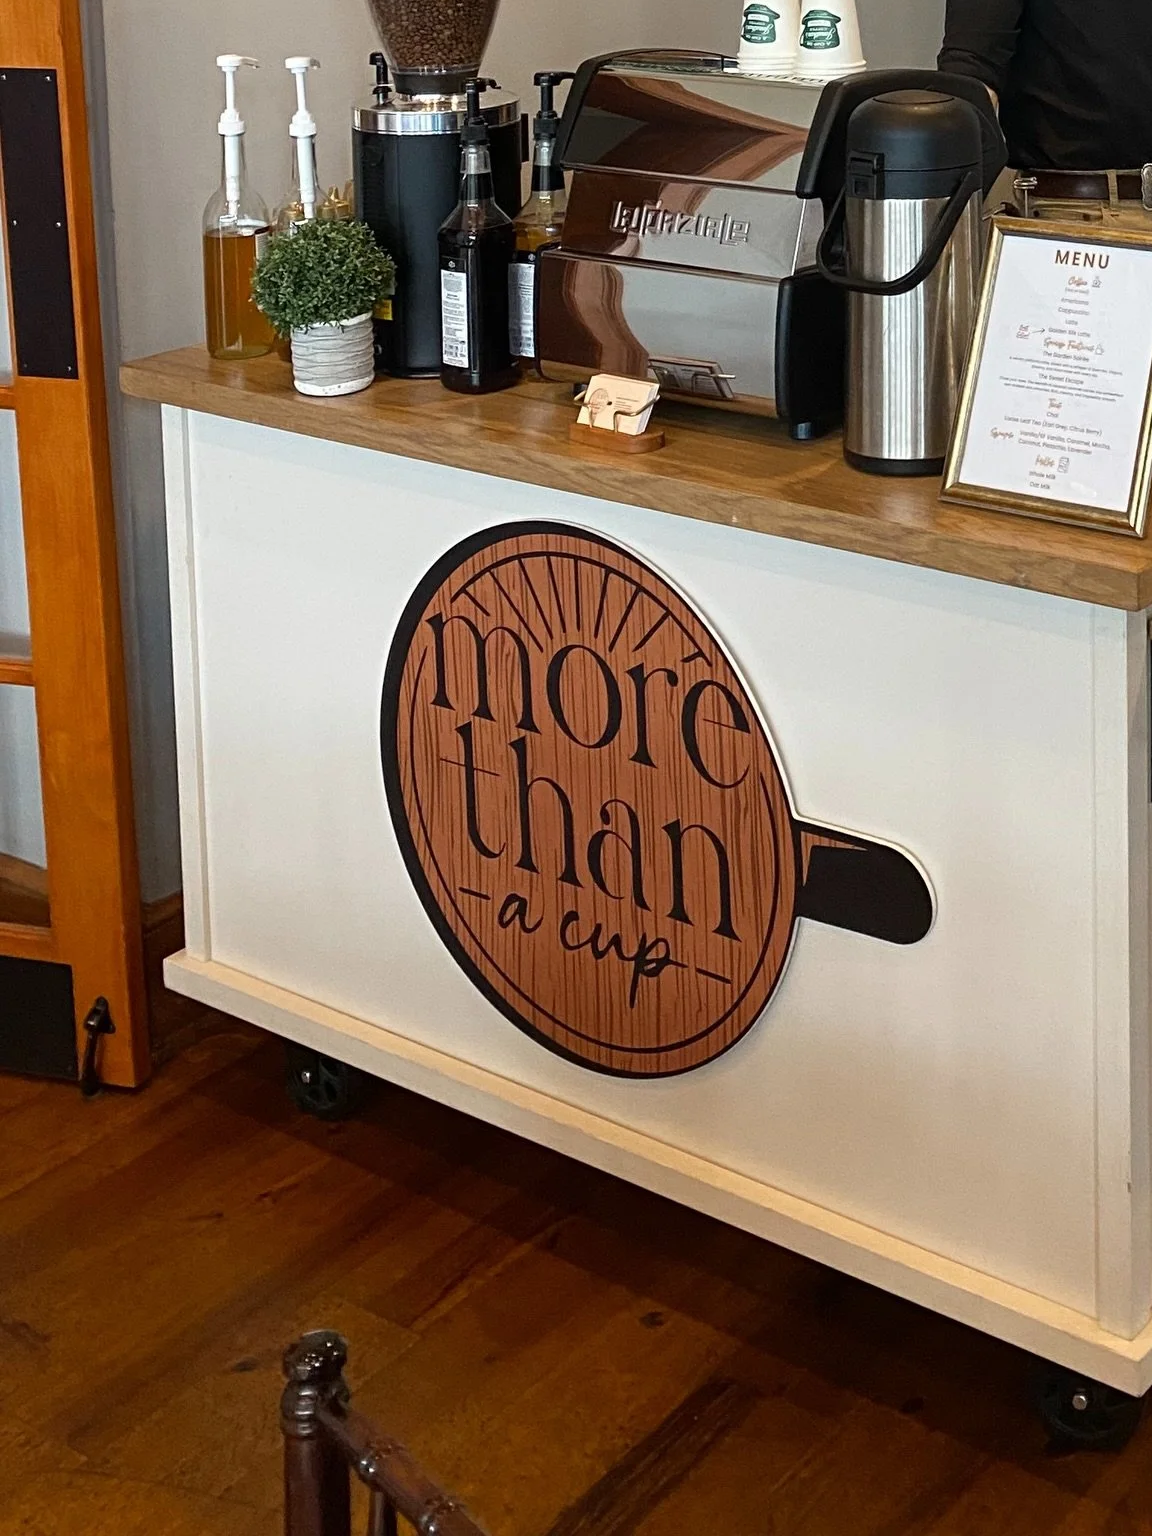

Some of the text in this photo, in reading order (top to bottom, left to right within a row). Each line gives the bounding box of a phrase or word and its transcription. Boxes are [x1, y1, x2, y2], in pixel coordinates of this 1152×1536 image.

[1055, 249, 1110, 269] MENU
[425, 611, 751, 790] more
[439, 720, 743, 943] than
[498, 891, 689, 1010] a cup
